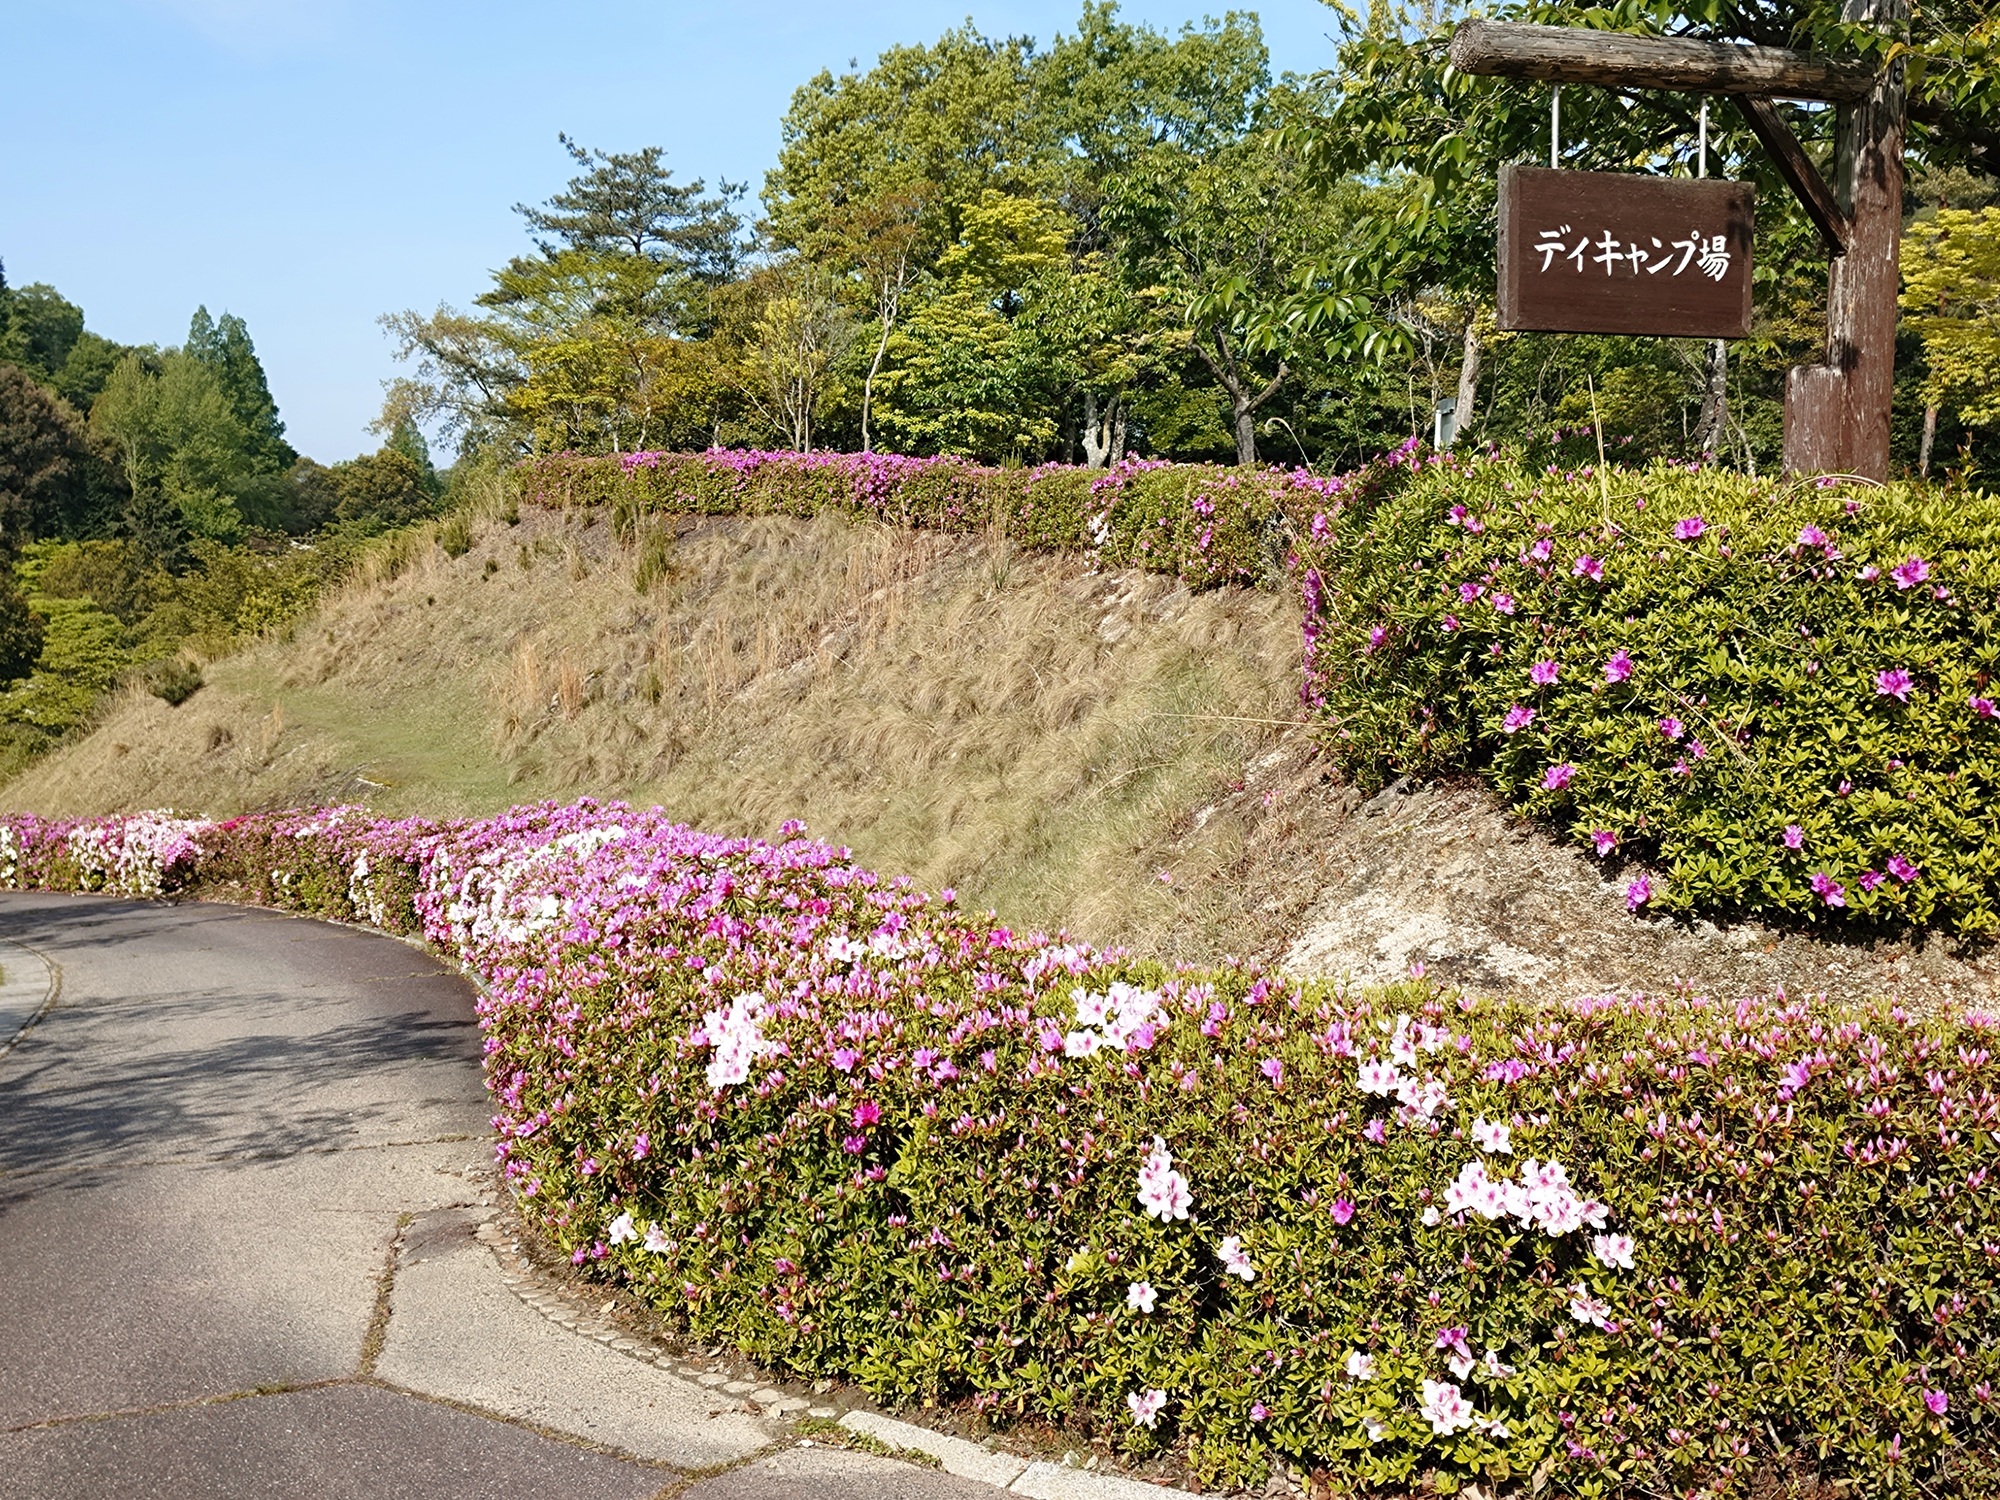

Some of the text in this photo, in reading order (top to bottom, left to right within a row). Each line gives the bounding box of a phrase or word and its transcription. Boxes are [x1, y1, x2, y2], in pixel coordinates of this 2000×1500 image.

[1533, 224, 1732, 282] デイキャンプ場
